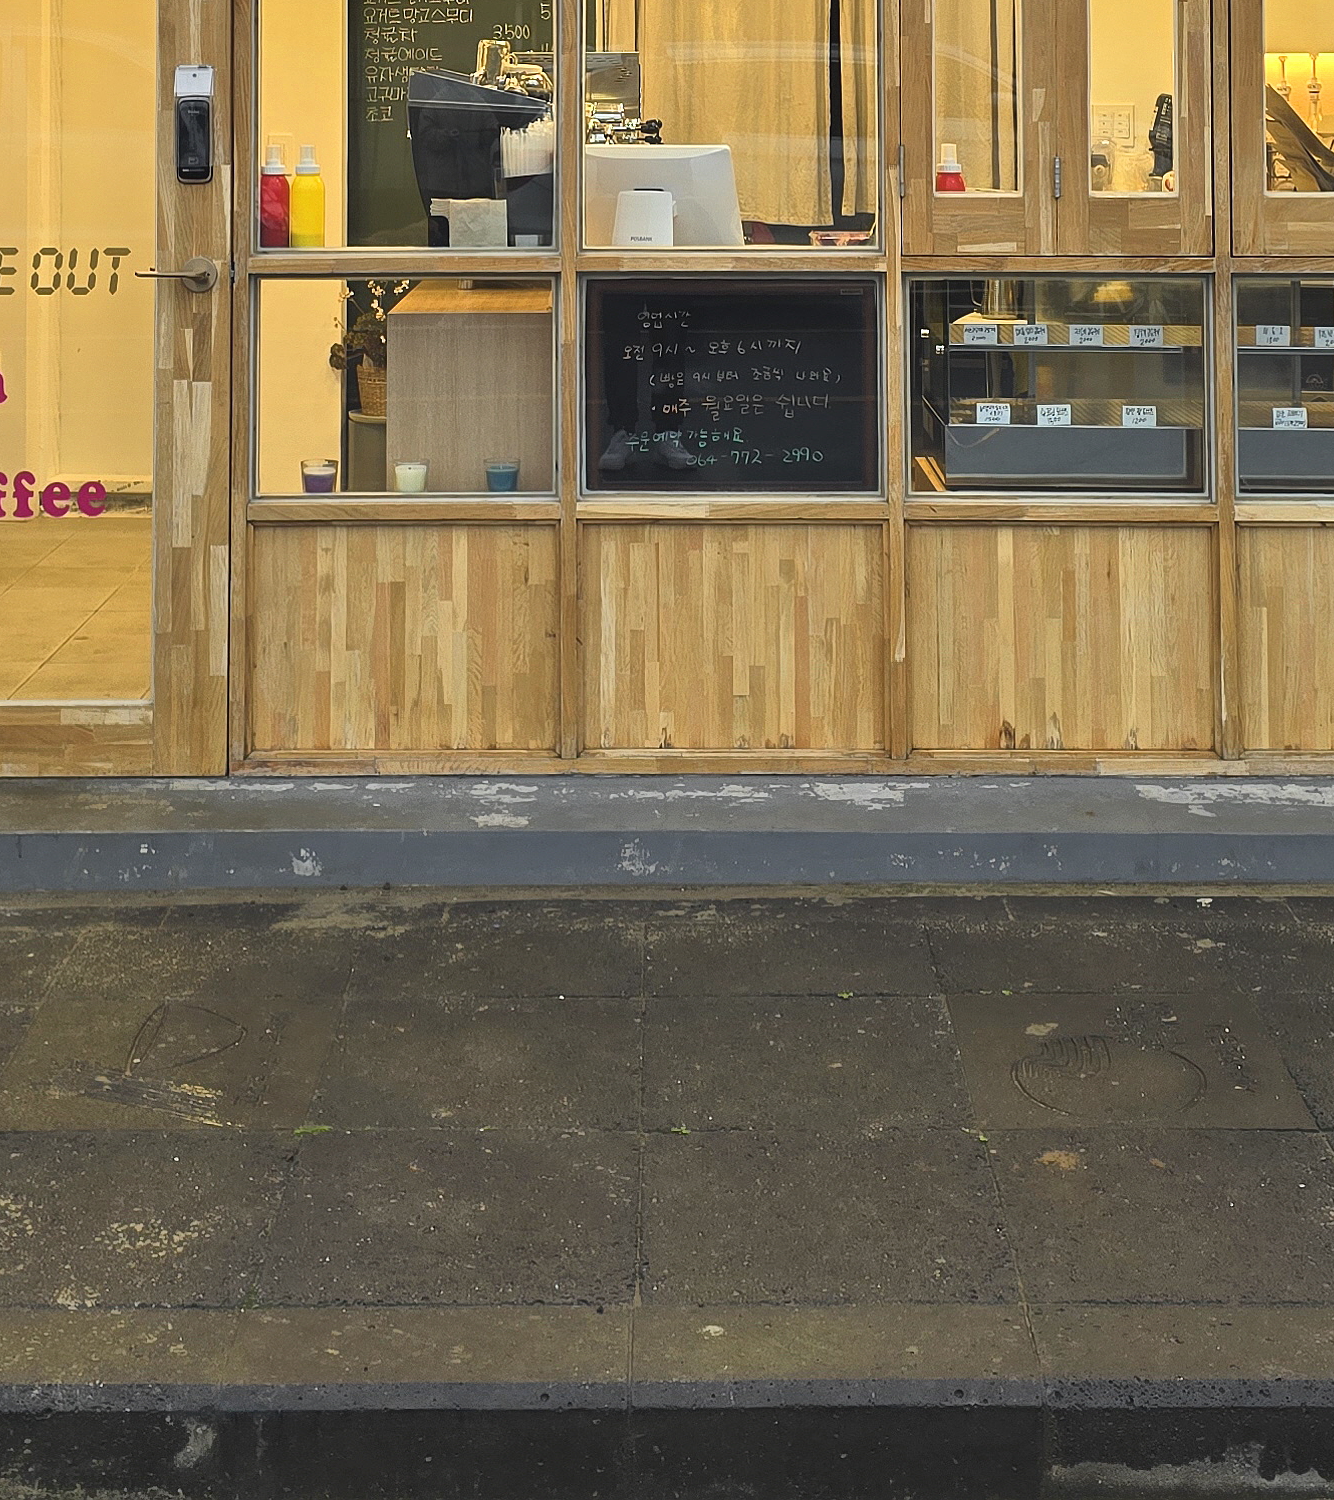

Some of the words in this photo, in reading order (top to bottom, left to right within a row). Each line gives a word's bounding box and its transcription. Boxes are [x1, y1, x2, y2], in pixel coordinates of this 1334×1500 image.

[30, 246, 132, 296] OUT
[637, 311, 692, 329] 영업시간
[622, 345, 645, 361] 오전
[708, 339, 731, 355] 오후
[701, 393, 764, 422] 월요일은
